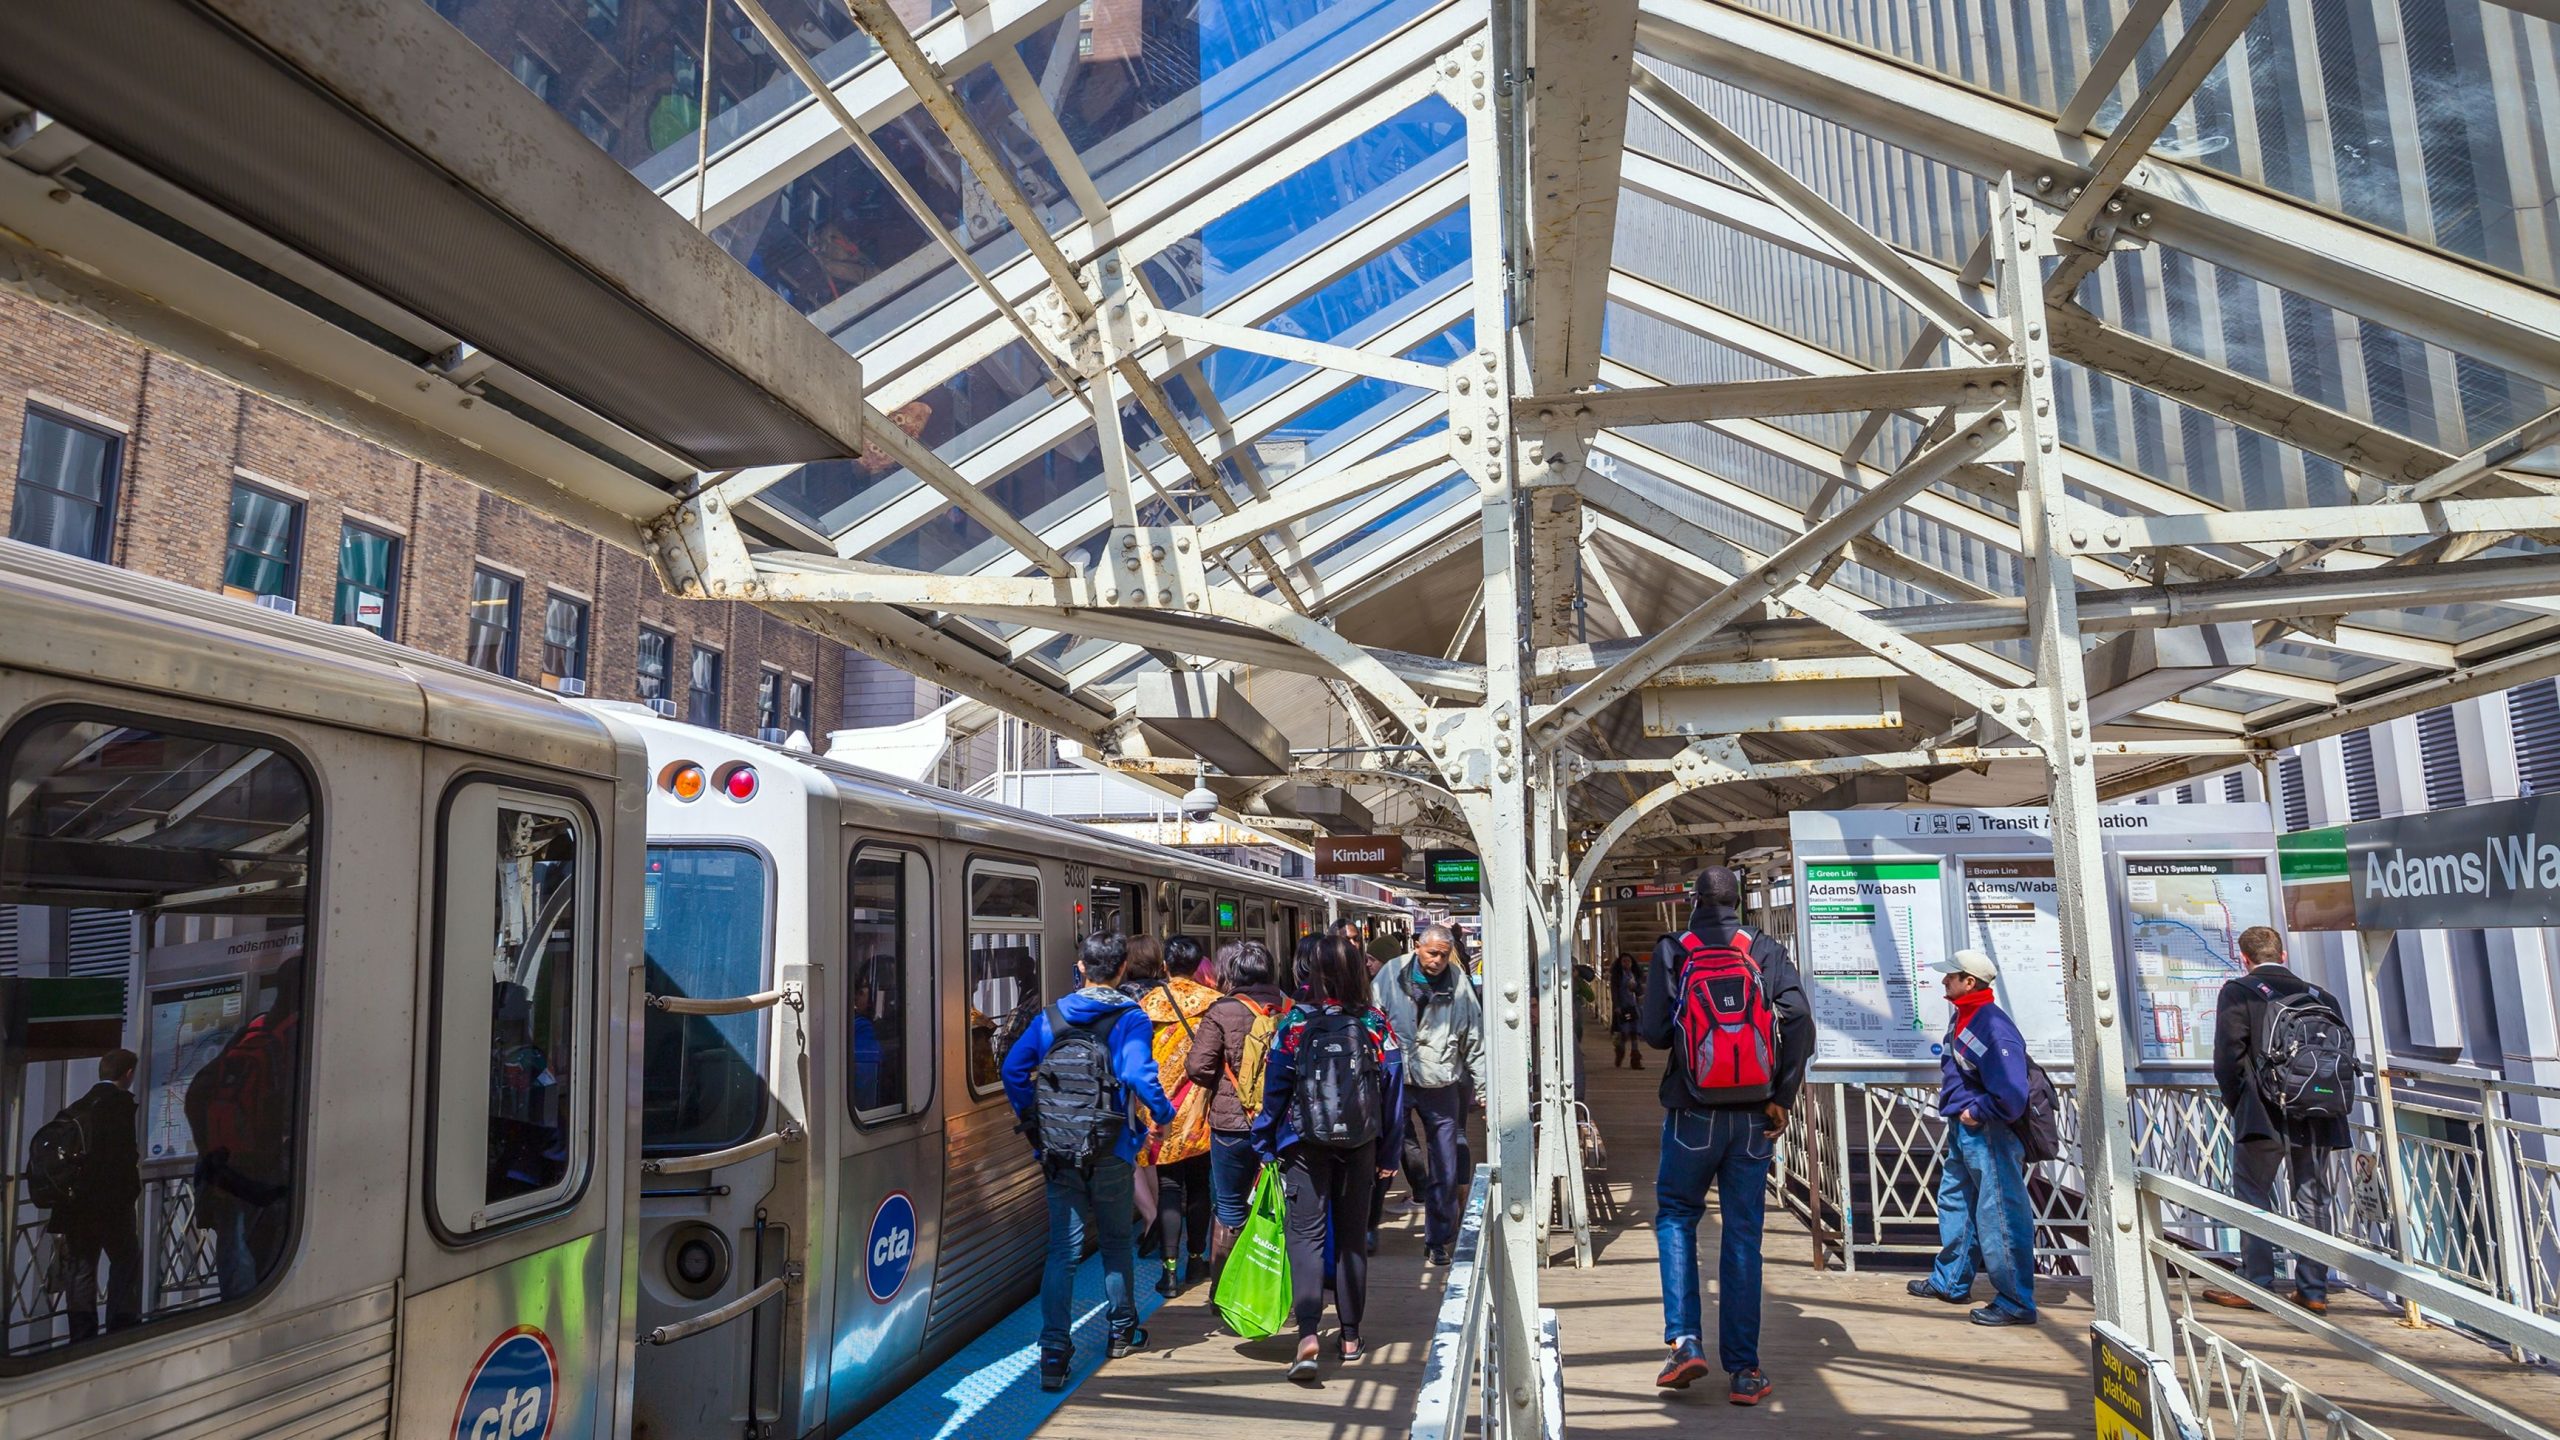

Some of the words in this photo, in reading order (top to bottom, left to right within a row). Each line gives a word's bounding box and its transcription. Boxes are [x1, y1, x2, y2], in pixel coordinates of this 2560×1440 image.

[1978, 816, 2038, 830] Transit
[1332, 848, 1385, 862] Kimball
[1064, 863, 1086, 889] 5033
[1841, 869, 1858, 877] Line
[2001, 867, 2019, 875] Line
[2138, 865, 2153, 873] Rail
[2170, 865, 2198, 874] System
[2200, 865, 2218, 873] Map
[1809, 883, 1917, 896] Adams/Wabash
[873, 1226, 910, 1267] cta
[2101, 1343, 2122, 1380] Stay
[2124, 1365, 2138, 1388] on
[2103, 1376, 2142, 1419] platform
[470, 1386, 542, 1440] cta
